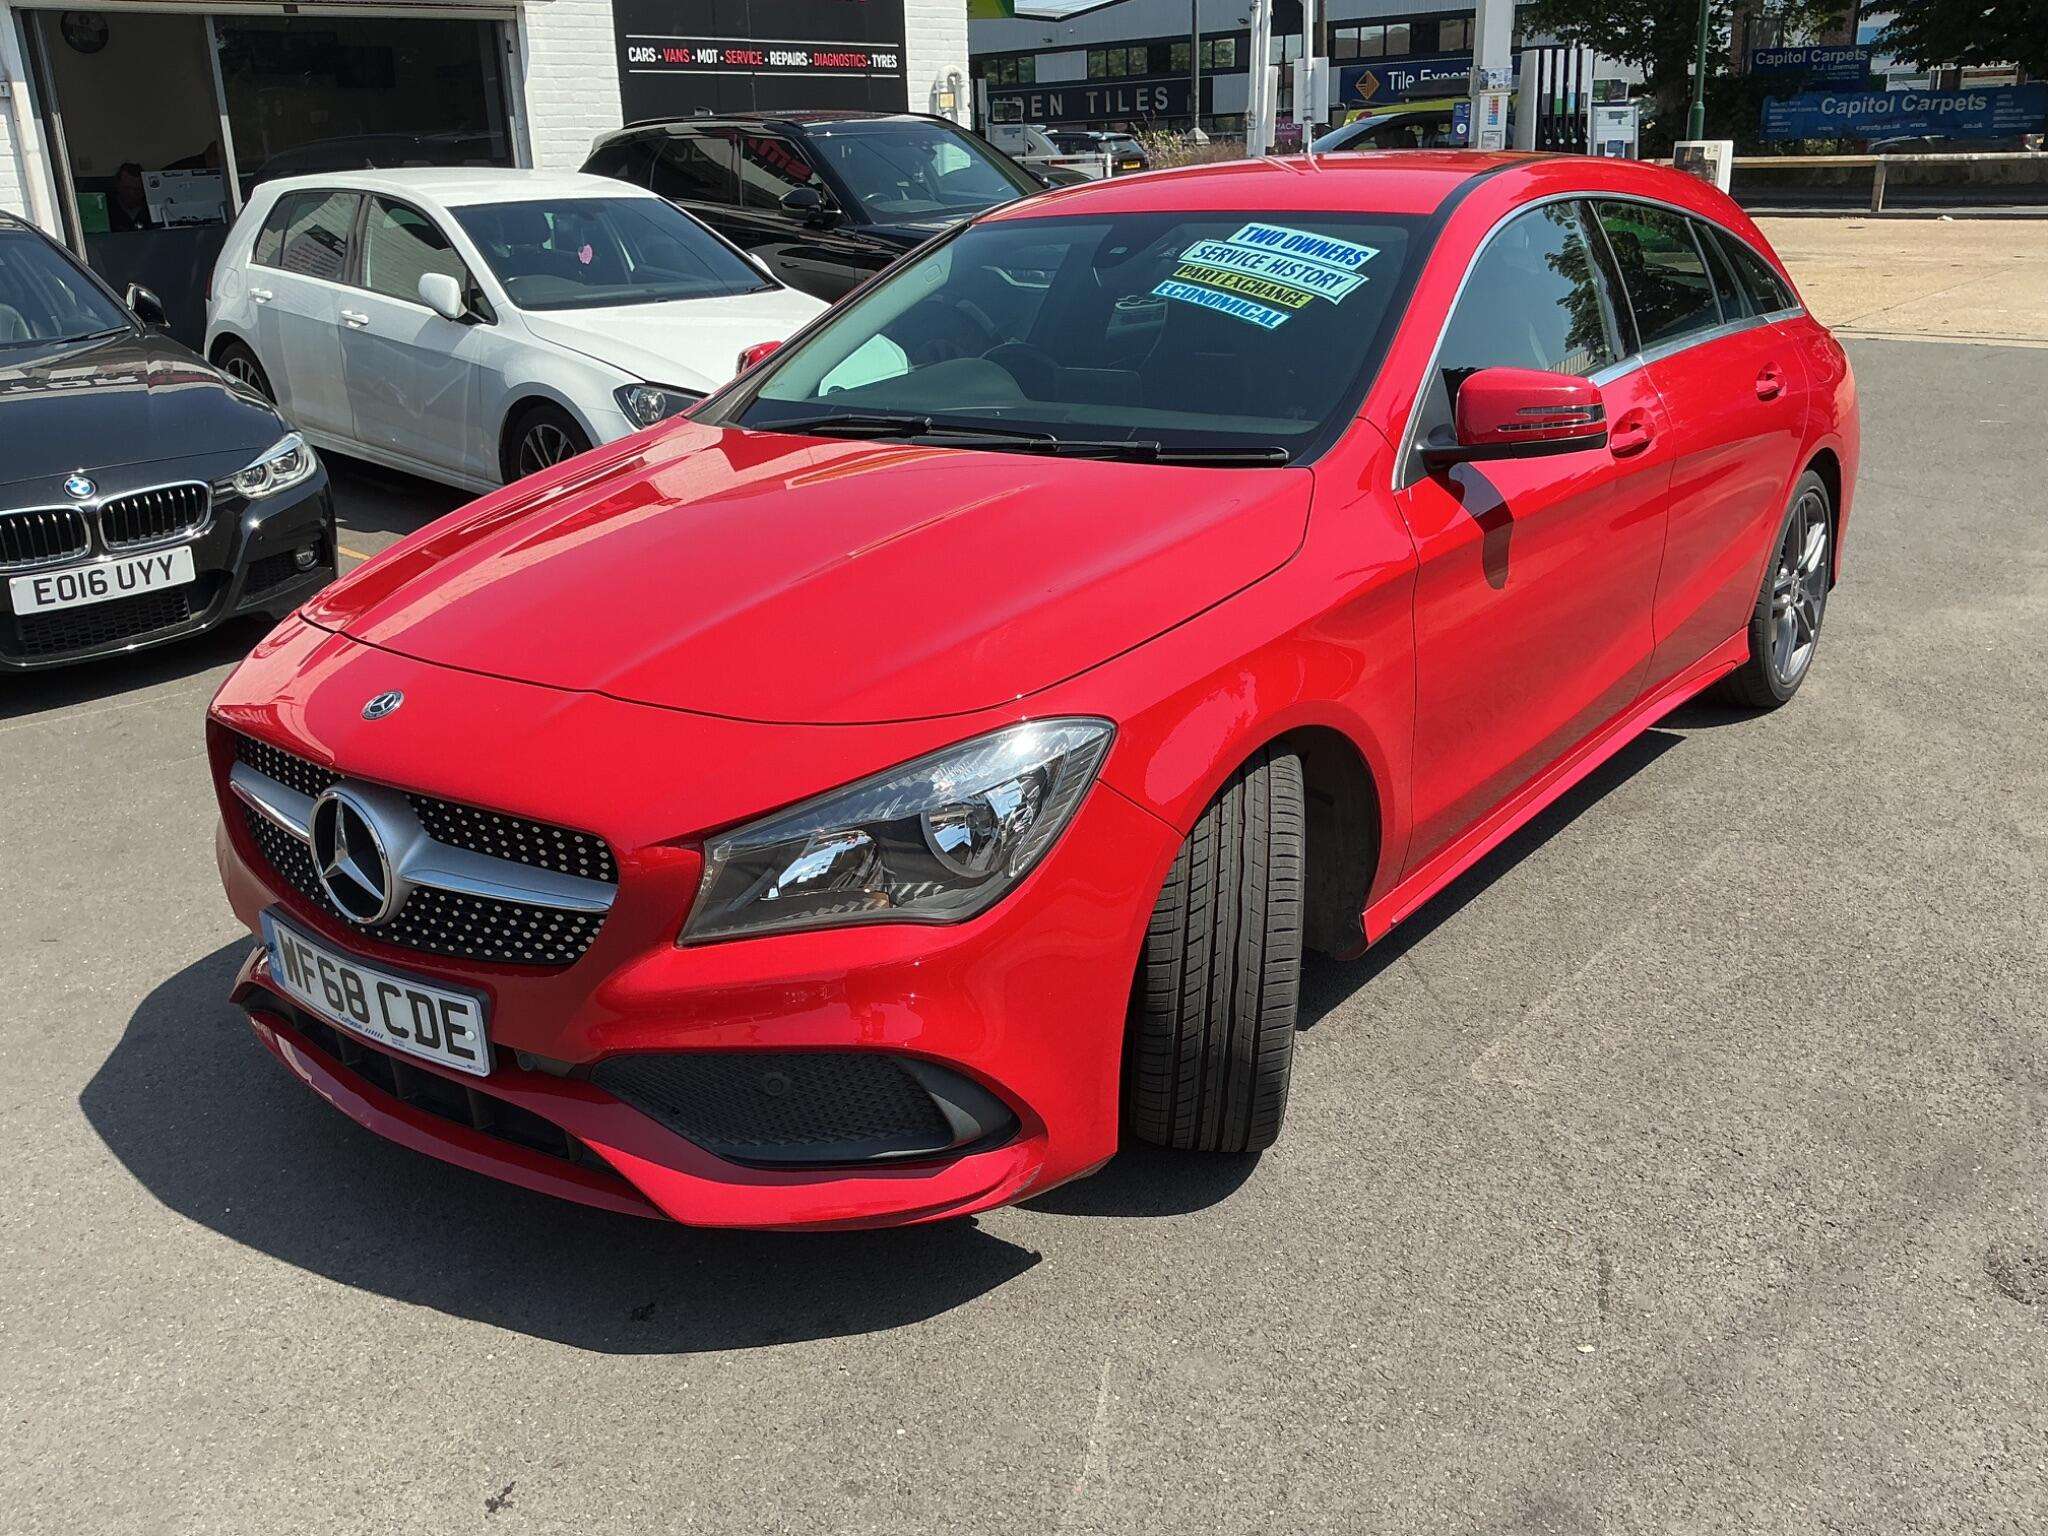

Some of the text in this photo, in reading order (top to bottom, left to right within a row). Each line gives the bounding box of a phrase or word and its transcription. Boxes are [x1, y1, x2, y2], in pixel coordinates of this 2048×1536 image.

[628, 47, 897, 69] CARS VANS MOT SERVICE REPAIRS DIAGNOSTICS TYRES
[1756, 48, 1868, 67] Capitol Carpets
[1387, 71, 1415, 90] Tile
[1086, 86, 1168, 114] TILES
[1821, 94, 1987, 118] Capitol Carpets
[1237, 226, 1370, 267] TWO OWNERS
[1192, 245, 1346, 291] SERVICE HISTORY
[1156, 282, 1284, 327] ECONOMICAL
[33, 554, 174, 606] EO16 UYY
[377, 981, 476, 1061] CDE
